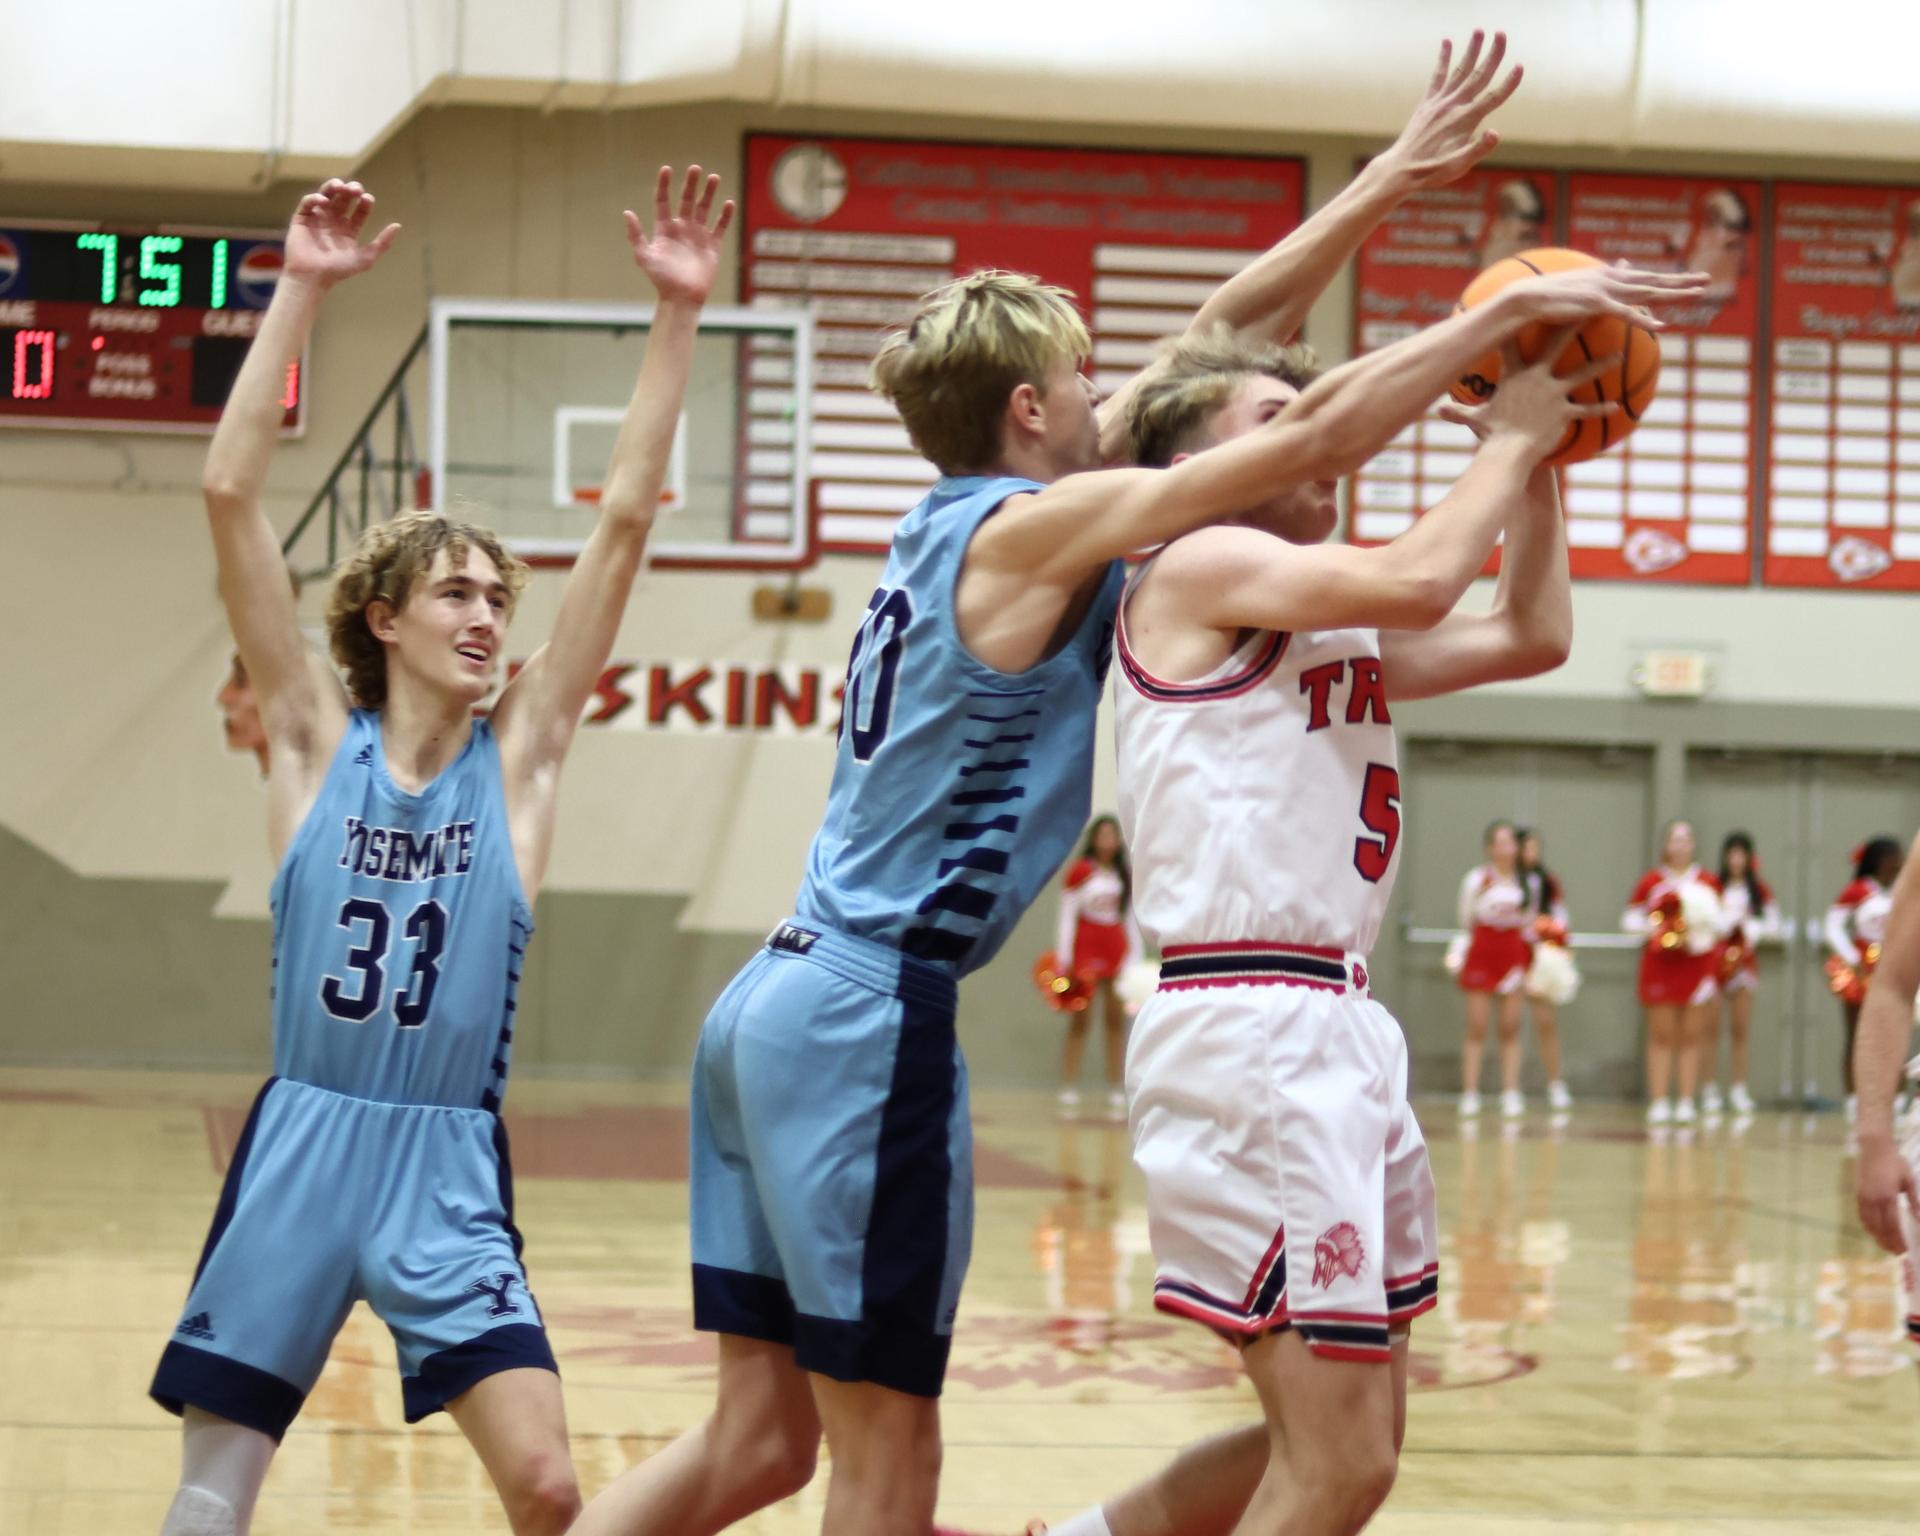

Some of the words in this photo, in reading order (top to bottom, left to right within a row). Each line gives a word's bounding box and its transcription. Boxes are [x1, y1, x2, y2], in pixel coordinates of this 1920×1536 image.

[1353, 762, 1401, 884] 5
[319, 897, 451, 1030] 33
[464, 1271, 526, 1320] Y
